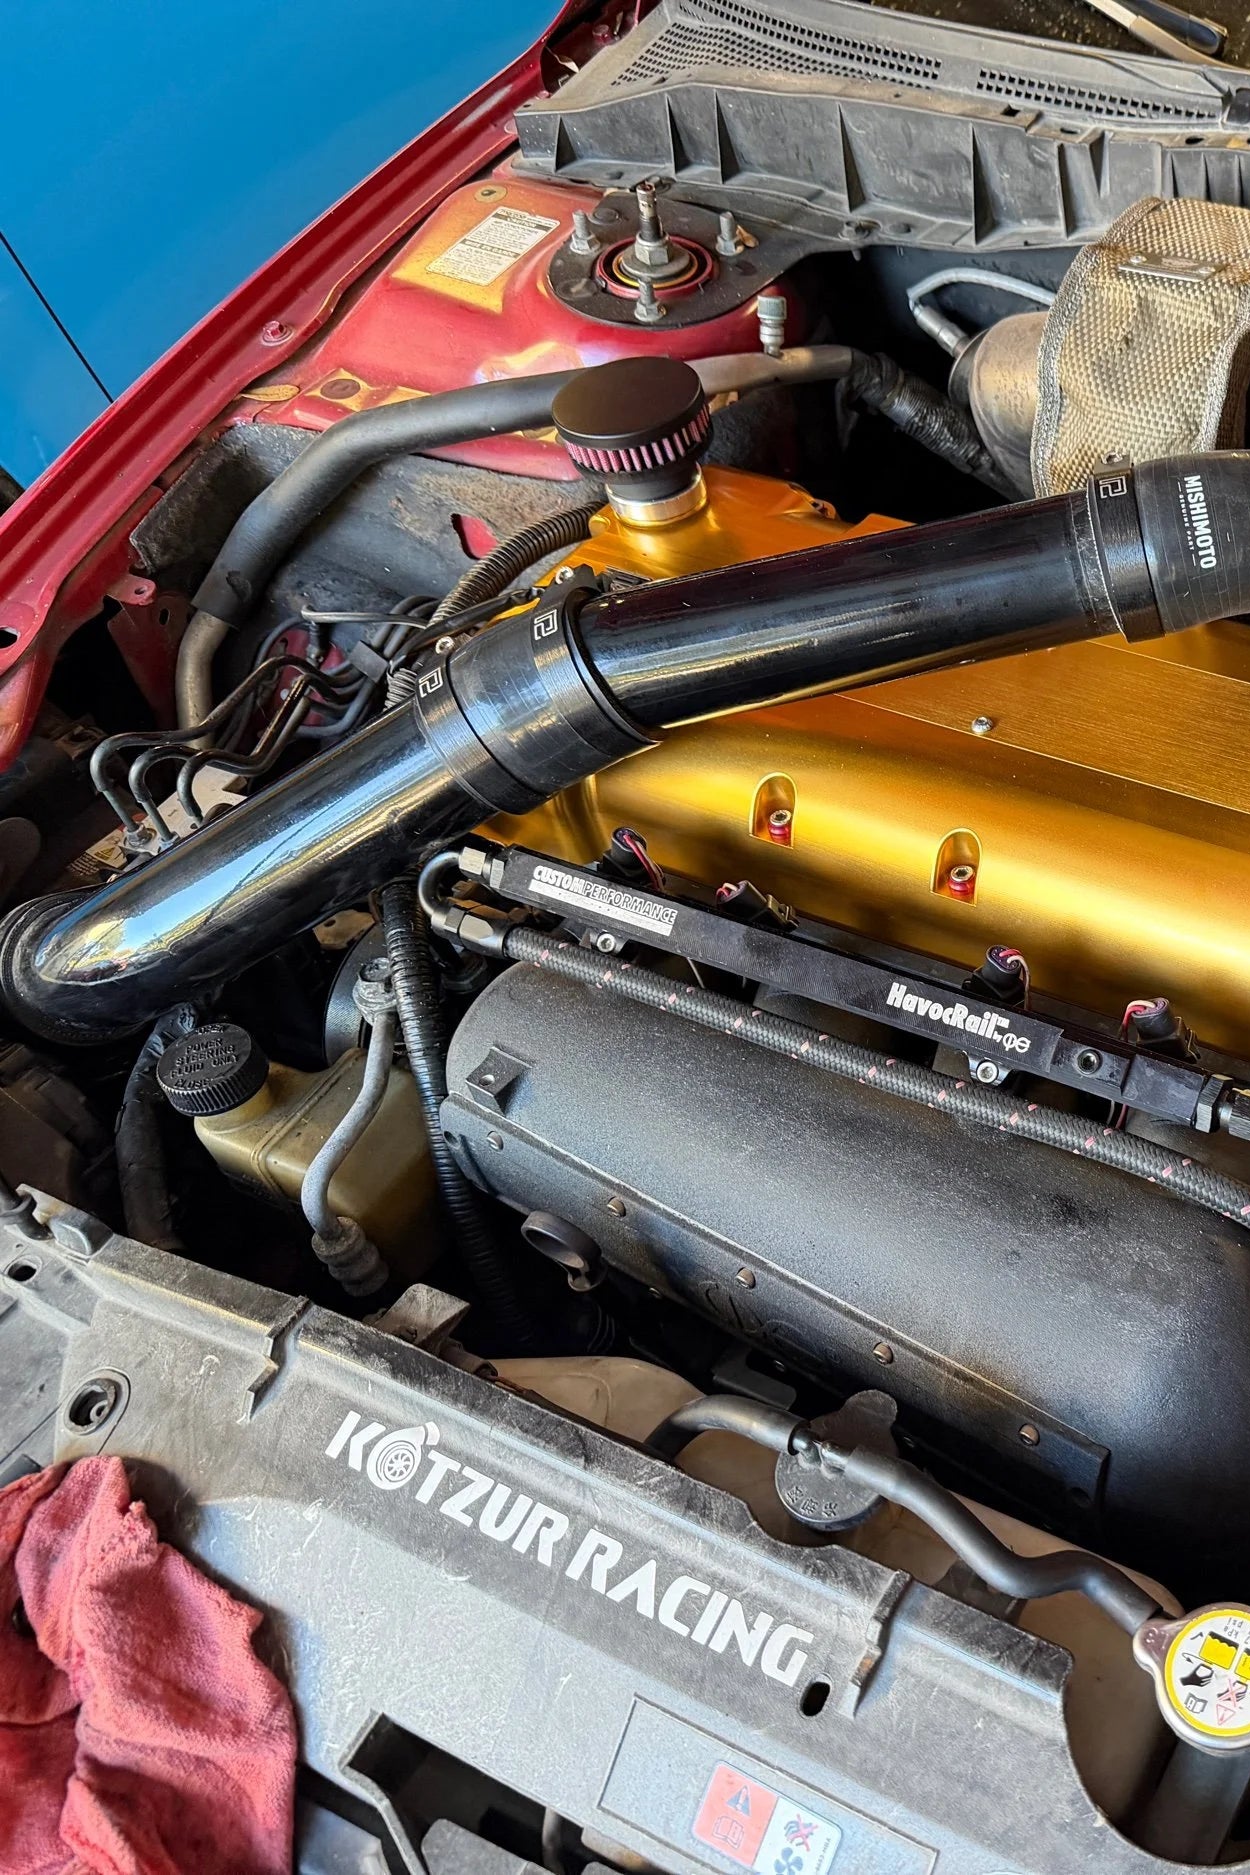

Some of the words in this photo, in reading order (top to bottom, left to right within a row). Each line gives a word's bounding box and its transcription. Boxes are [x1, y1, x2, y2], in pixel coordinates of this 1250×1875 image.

[1179, 494, 1190, 527] GENUINE
[1186, 531, 1195, 551] PART
[1184, 474, 1217, 569] MISHIMOTO
[175, 1045, 235, 1067] STEERING
[185, 1038, 223, 1055] POWER
[170, 1063, 204, 1079] FLUID
[211, 1055, 238, 1068] ONLY
[566, 1528, 815, 1688] RACING
